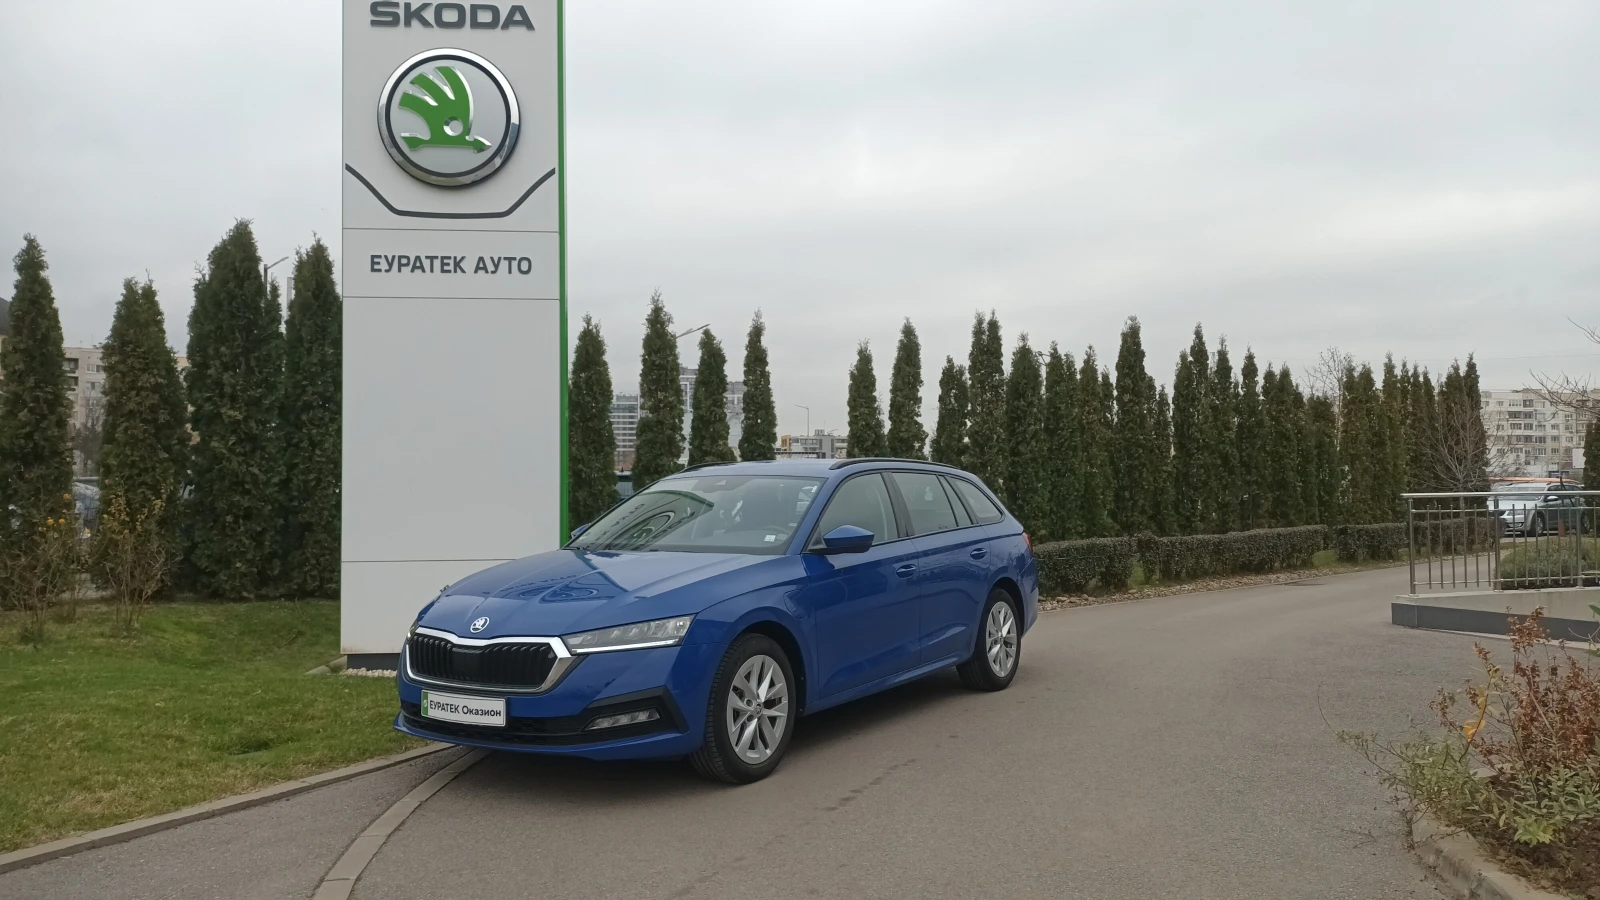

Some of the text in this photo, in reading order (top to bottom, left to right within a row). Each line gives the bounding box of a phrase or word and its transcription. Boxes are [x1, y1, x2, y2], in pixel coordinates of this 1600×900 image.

[370, 254, 533, 275] ЕУРАТЕК АУТО
[429, 700, 502, 717] ЕУРАТЕК Оказион
